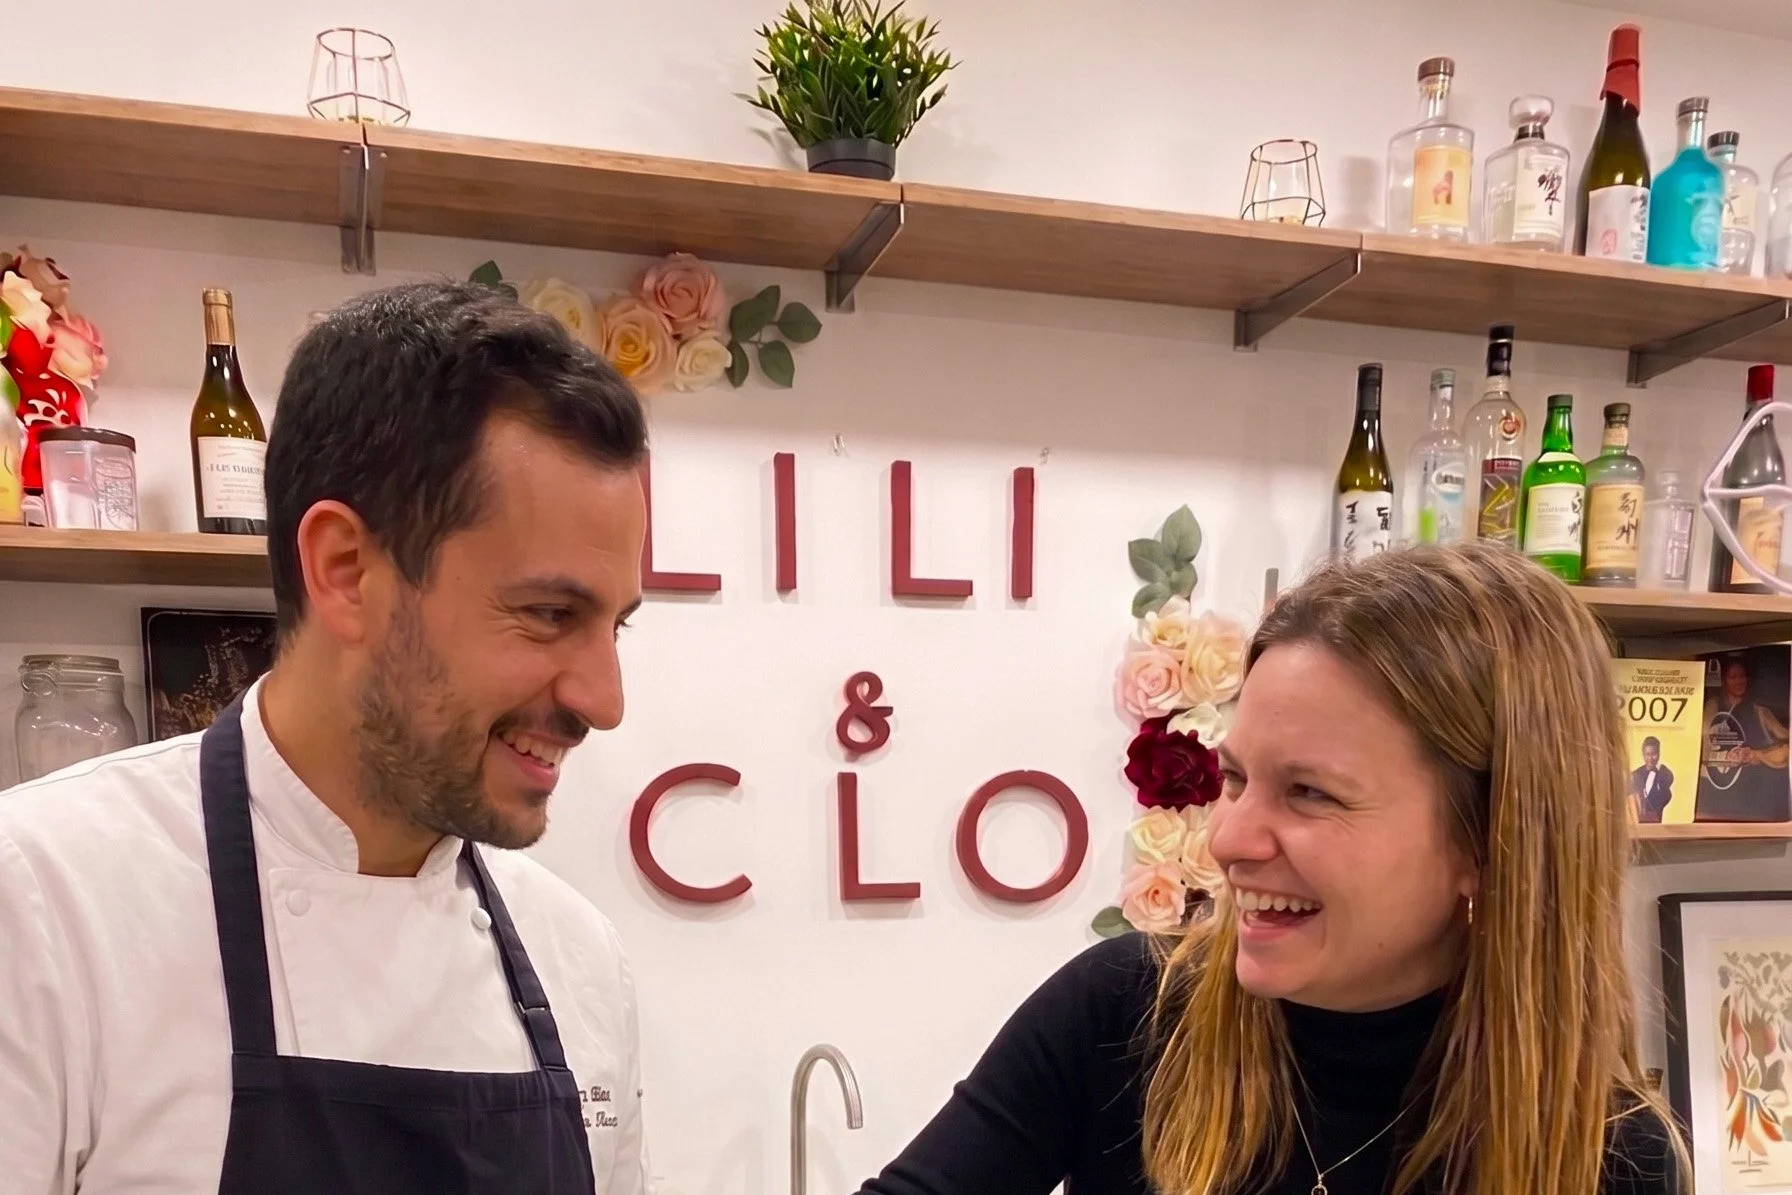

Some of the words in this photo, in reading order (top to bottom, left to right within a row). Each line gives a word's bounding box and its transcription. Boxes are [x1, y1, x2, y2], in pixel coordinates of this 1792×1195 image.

[641, 451, 1034, 599] LILI
[836, 671, 893, 753] &
[1628, 696, 1689, 722] 007
[630, 762, 1089, 901] CLO
